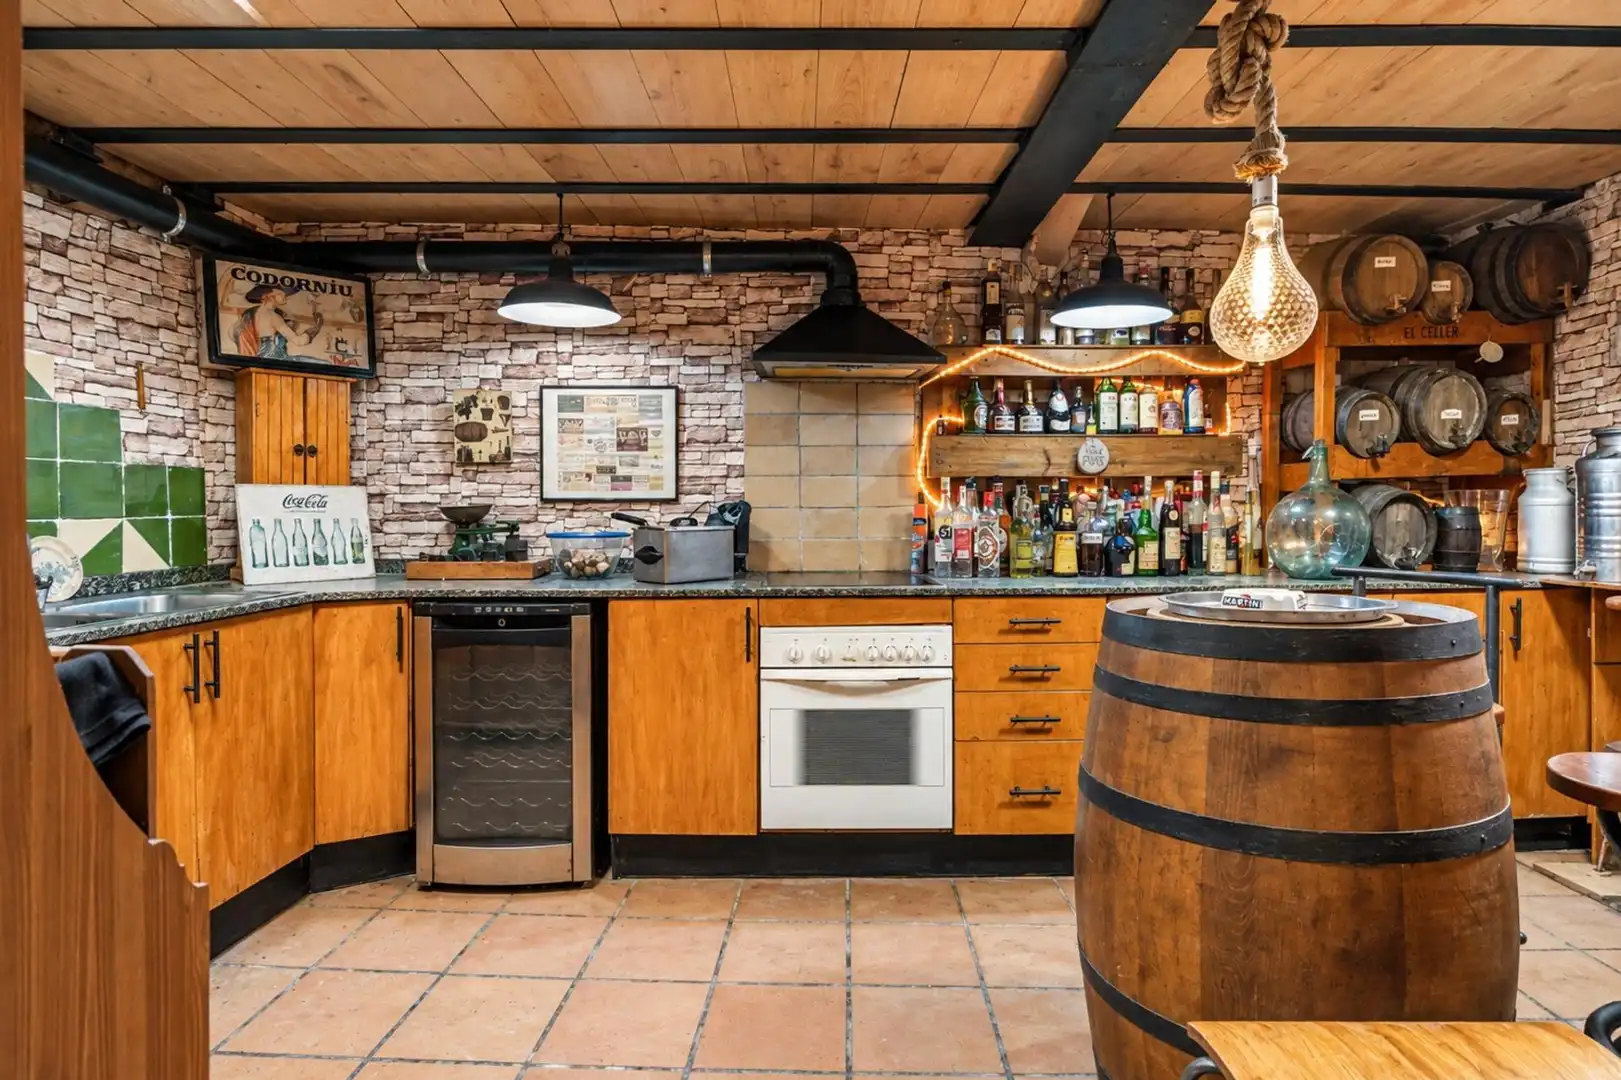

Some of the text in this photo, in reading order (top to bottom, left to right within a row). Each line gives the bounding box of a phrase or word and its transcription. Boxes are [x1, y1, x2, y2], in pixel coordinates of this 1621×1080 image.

[1404, 326, 1458, 339] EL CELLER
[1223, 596, 1263, 608] MARTINI
